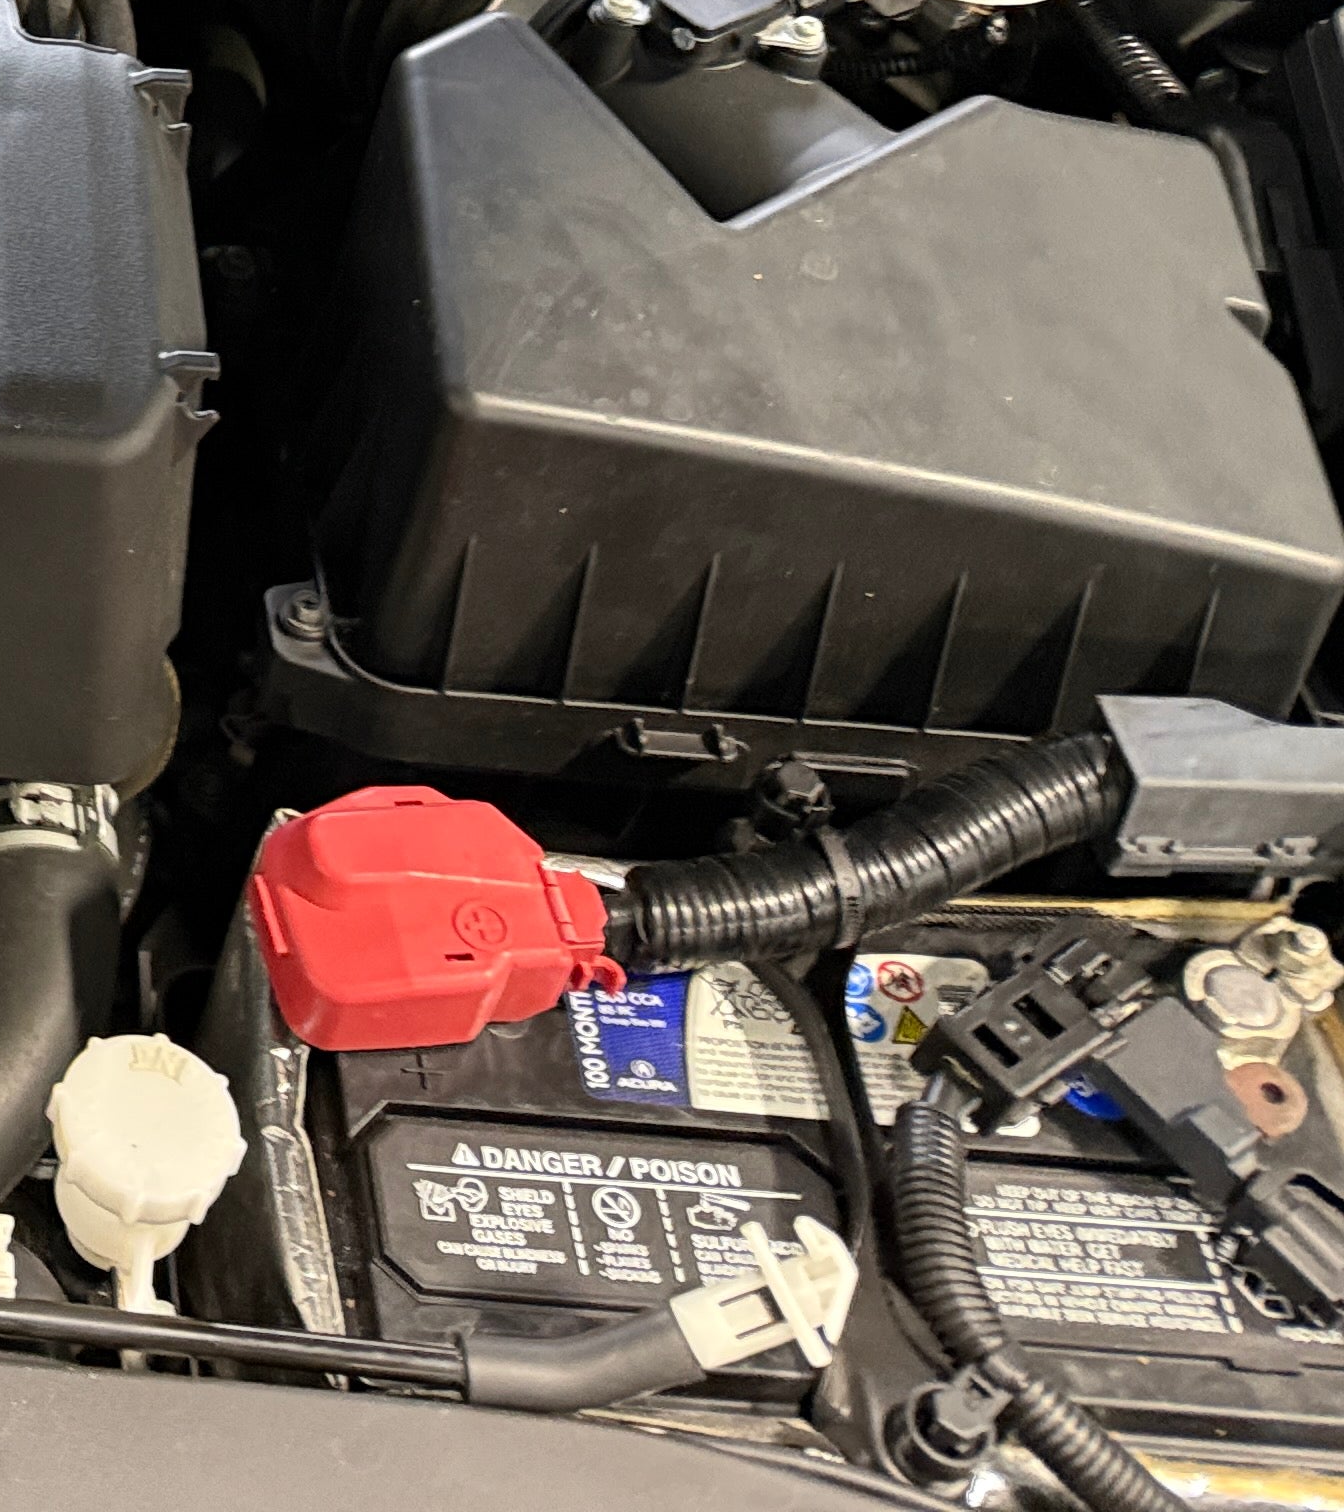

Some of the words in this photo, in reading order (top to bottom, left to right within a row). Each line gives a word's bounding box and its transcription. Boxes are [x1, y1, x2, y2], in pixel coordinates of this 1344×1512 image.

[581, 1057, 611, 1089] 100
[616, 1076, 678, 1092] ACURA
[481, 1145, 603, 1177] DANGER
[630, 1157, 742, 1187] POISON
